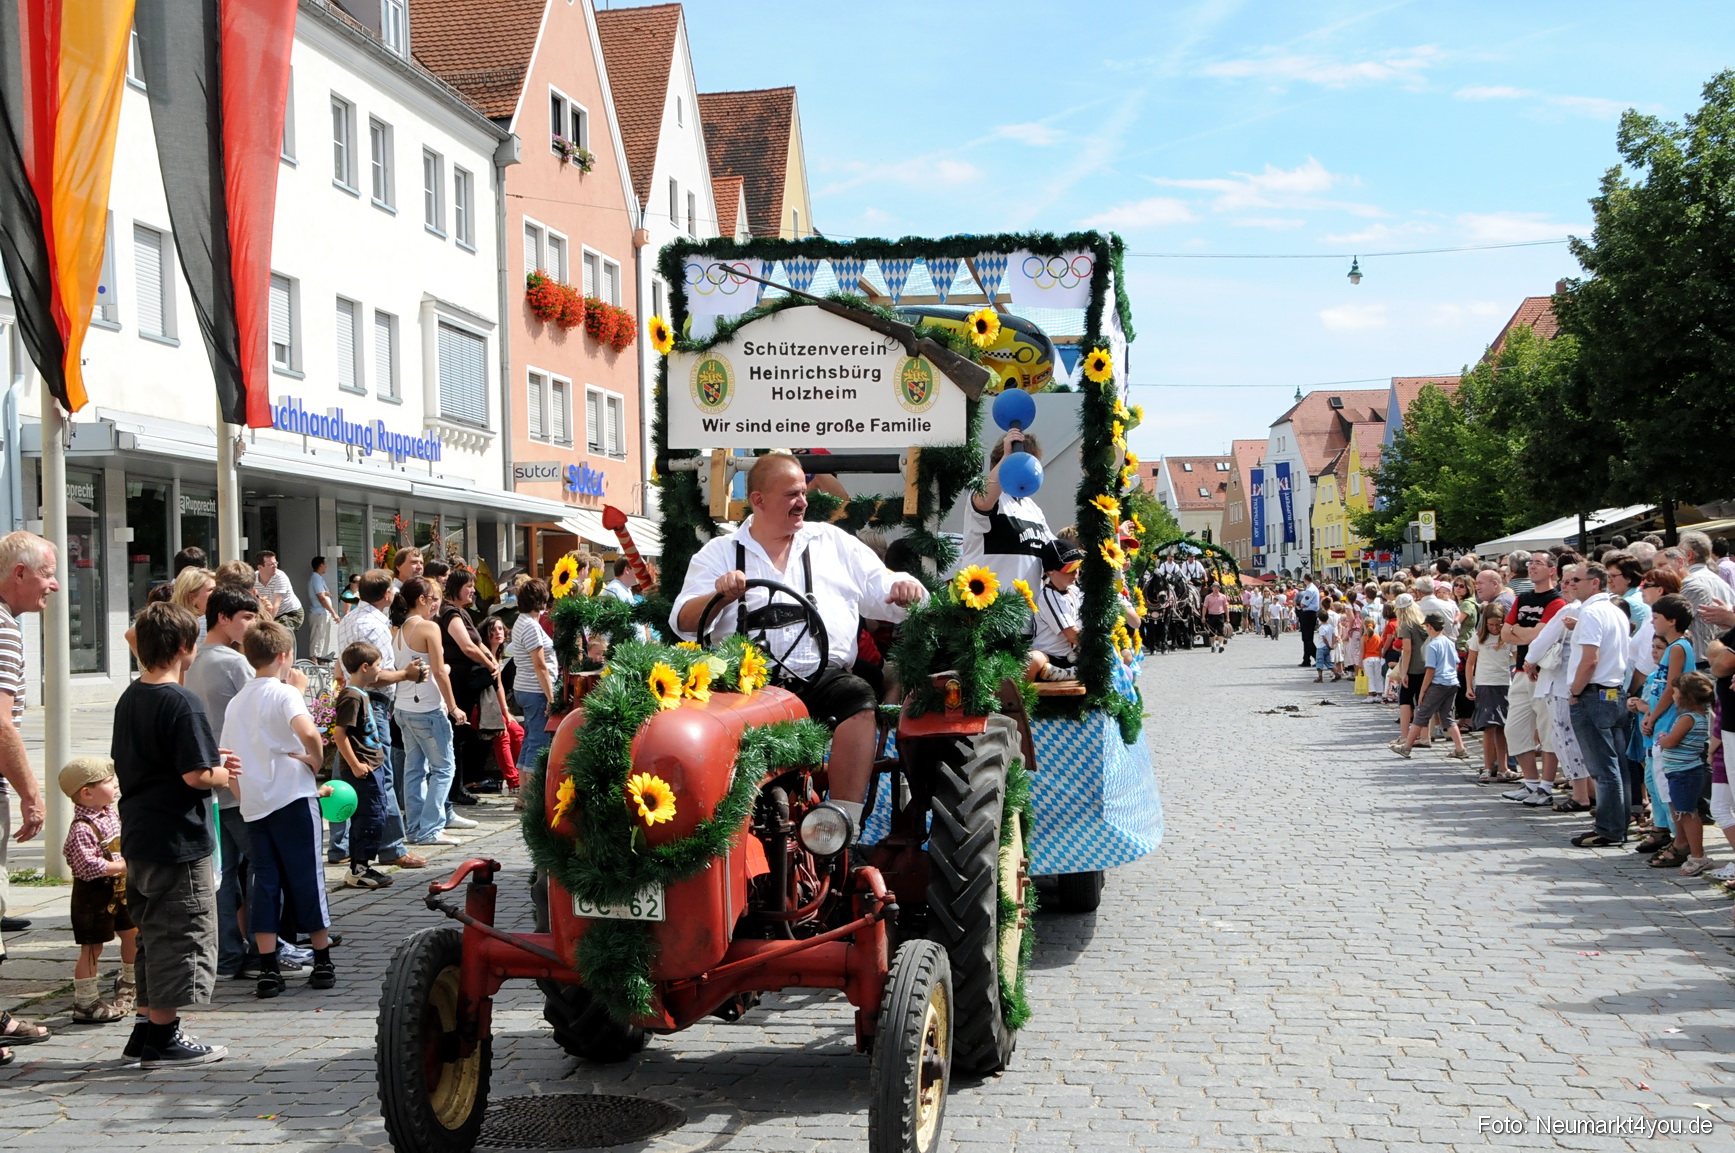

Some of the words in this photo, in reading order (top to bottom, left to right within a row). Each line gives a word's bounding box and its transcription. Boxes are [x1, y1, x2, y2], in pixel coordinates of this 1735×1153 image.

[743, 341, 887, 356] Schützenverein
[749, 364, 882, 382] Heinrichsbürg
[771, 386, 857, 400] Holzheim
[269, 394, 373, 457] uchhandlung
[377, 418, 442, 464] Rupprecht
[702, 418, 731, 433] Wir
[735, 418, 772, 433] sind
[775, 418, 811, 433] eine
[815, 418, 865, 436] große
[870, 417, 932, 433] Familie
[66, 482, 94, 500] pprecht
[185, 495, 217, 515] Rupprecht
[629, 896, 659, 919] 62
